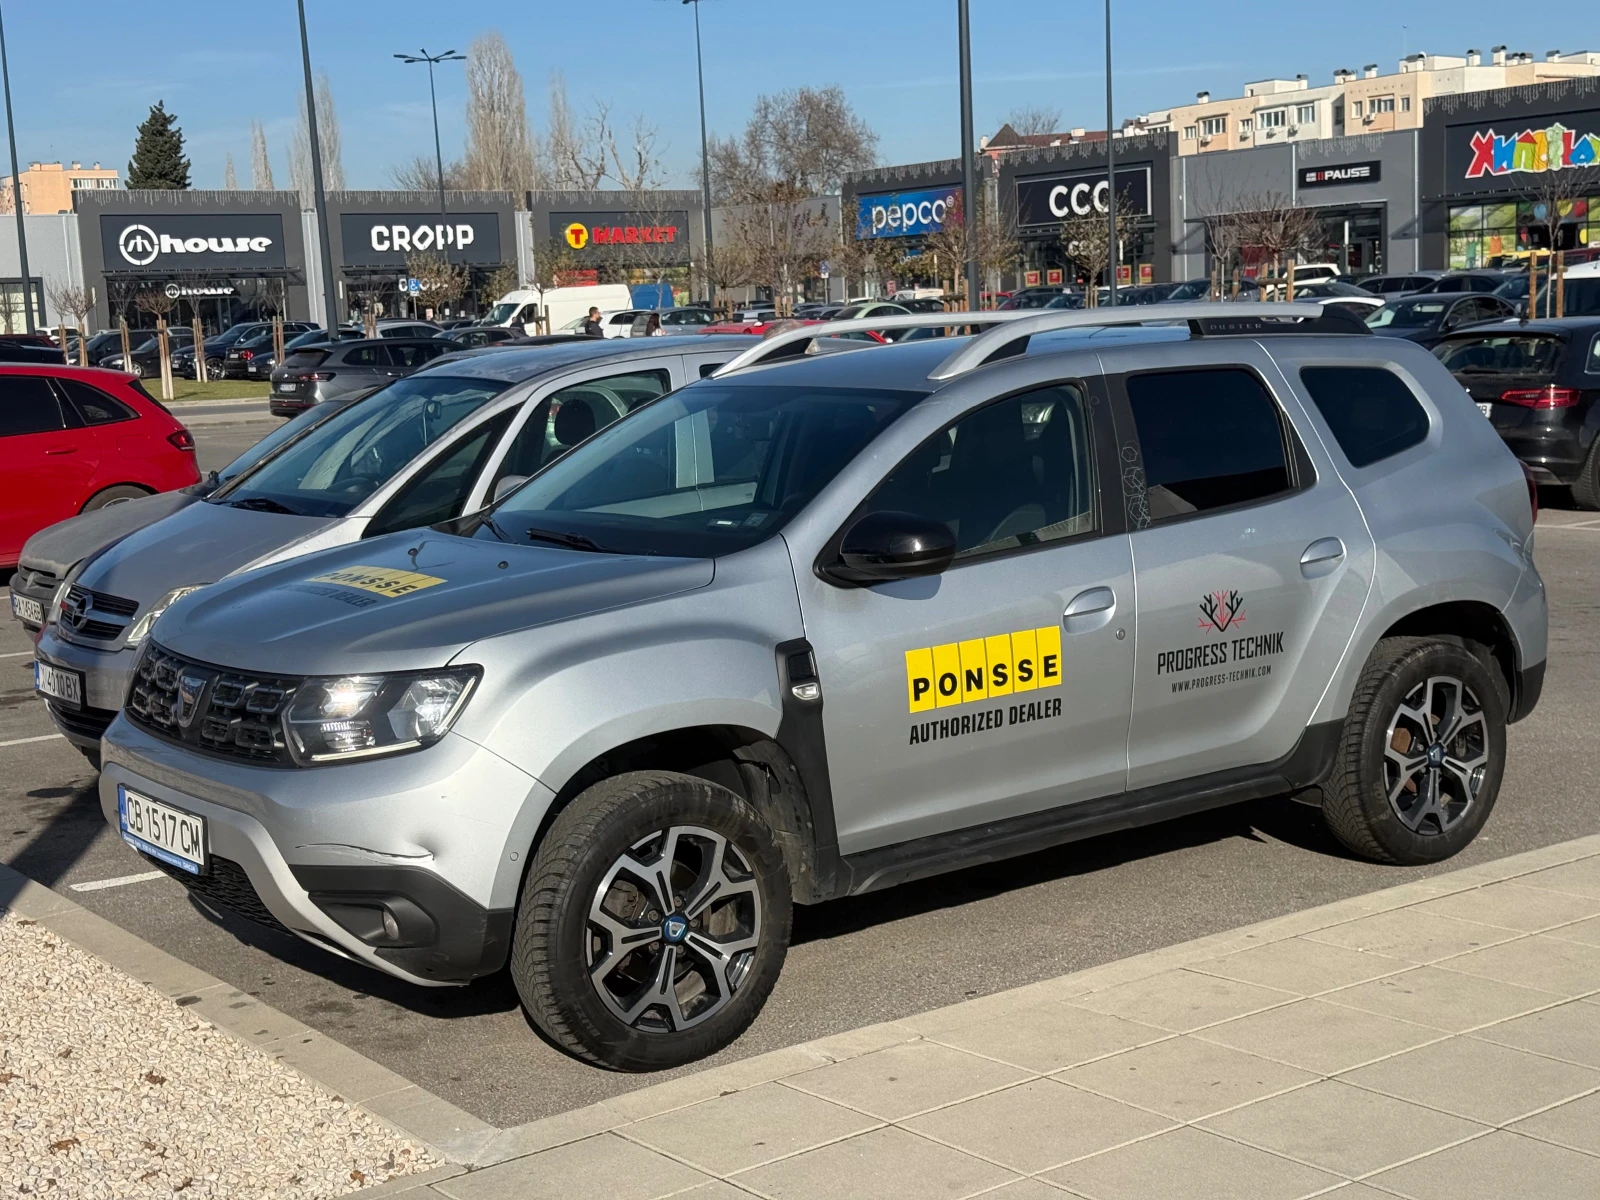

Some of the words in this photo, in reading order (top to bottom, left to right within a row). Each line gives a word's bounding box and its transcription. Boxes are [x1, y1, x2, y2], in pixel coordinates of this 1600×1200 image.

[1324, 166, 1370, 181] PAUSE
[1049, 180, 1109, 217] CCC
[872, 199, 947, 235] pepco
[160, 234, 273, 253] house
[371, 225, 474, 252] CROPP
[571, 229, 584, 245] T
[592, 226, 677, 244] MARKET
[1157, 642, 1227, 675] PROGRESS
[1231, 631, 1284, 661] TECHNIK
[913, 654, 1058, 702] PONSSE
[1171, 665, 1272, 693] WWW.PROGRESS-TECHNIK.COM
[909, 709, 1003, 745] AUTHORIZED
[1009, 698, 1062, 725] DEALER
[128, 797, 144, 833] CB
[146, 805, 177, 848] 1517
[180, 819, 201, 859] CM
